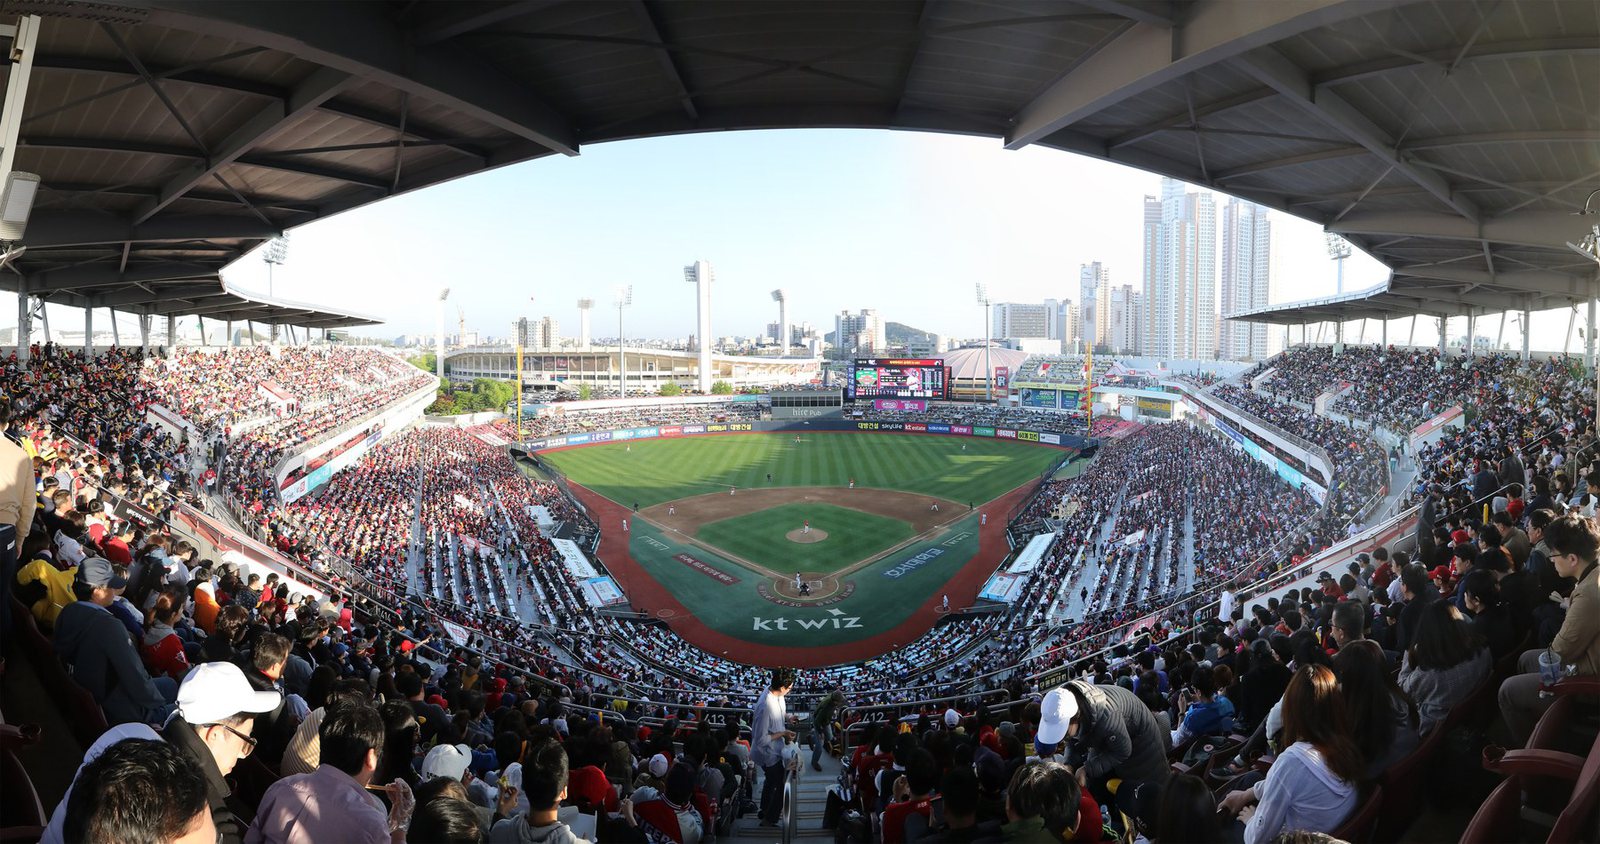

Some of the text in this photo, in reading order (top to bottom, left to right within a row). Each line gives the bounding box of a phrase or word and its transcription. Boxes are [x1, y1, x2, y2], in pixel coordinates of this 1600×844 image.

[792, 408, 808, 416] hite
[753, 608, 864, 631] kt wiz
[703, 713, 725, 725] 413
[862, 711, 885, 723] 412
